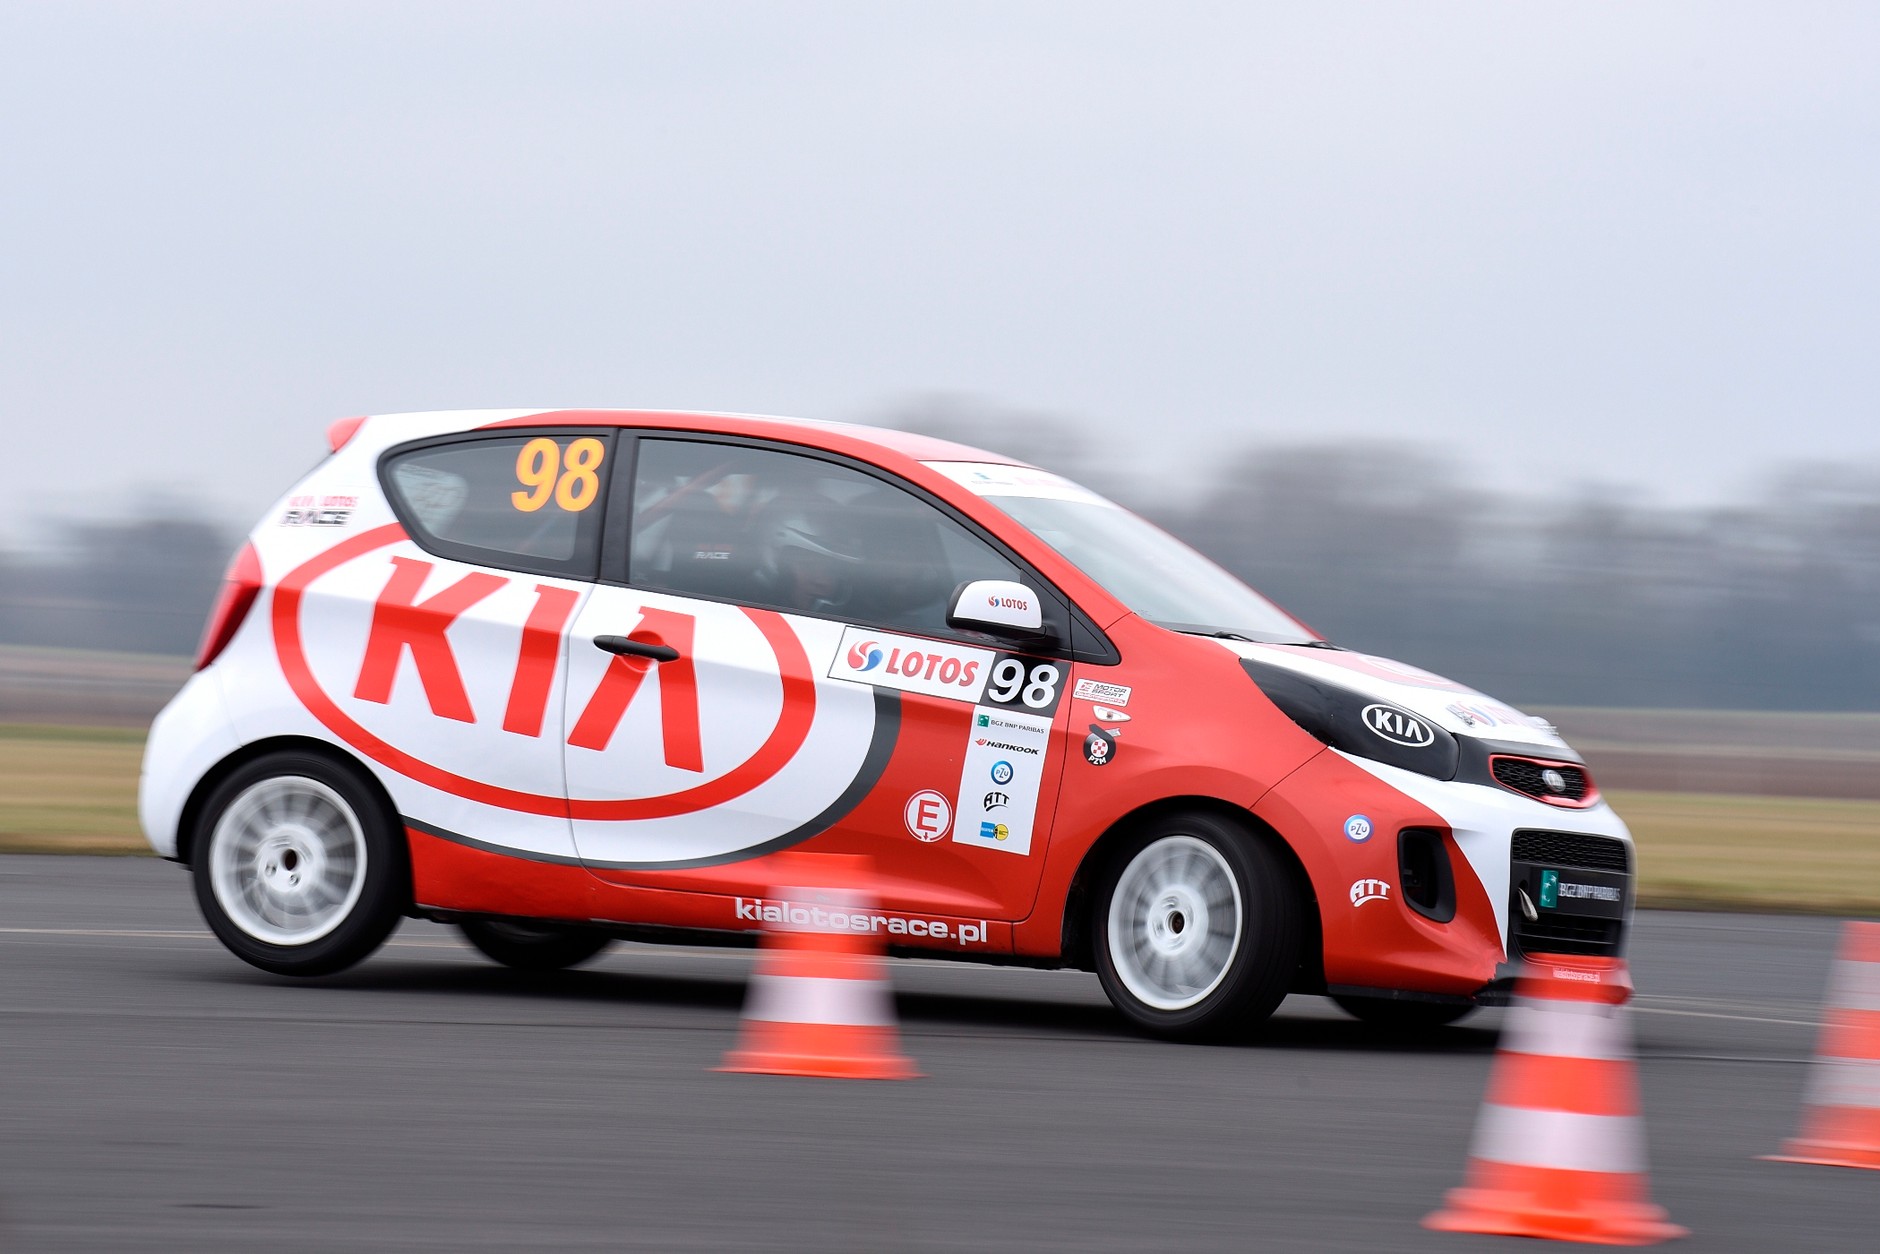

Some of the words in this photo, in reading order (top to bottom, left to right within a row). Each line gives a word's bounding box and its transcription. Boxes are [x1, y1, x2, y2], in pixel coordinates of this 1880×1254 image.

[511, 437, 605, 513] 98
[694, 551, 731, 560] RACE
[1001, 597, 1028, 611] LOTOS
[353, 555, 704, 773] KIA
[885, 647, 979, 688] LOTOS
[988, 658, 1060, 709] 98
[1094, 683, 1127, 694] MOTOR
[1004, 722, 1019, 730] BNP
[1018, 724, 1045, 734] PARIBAS
[1374, 708, 1424, 742] KIA
[1088, 754, 1107, 765] PZM
[995, 767, 1009, 779] PZU
[983, 791, 1010, 812] ATT
[916, 799, 941, 833] E
[1350, 822, 1368, 836] PZU
[1349, 878, 1391, 908] ATT
[735, 897, 988, 946] kialotosrace.pl
